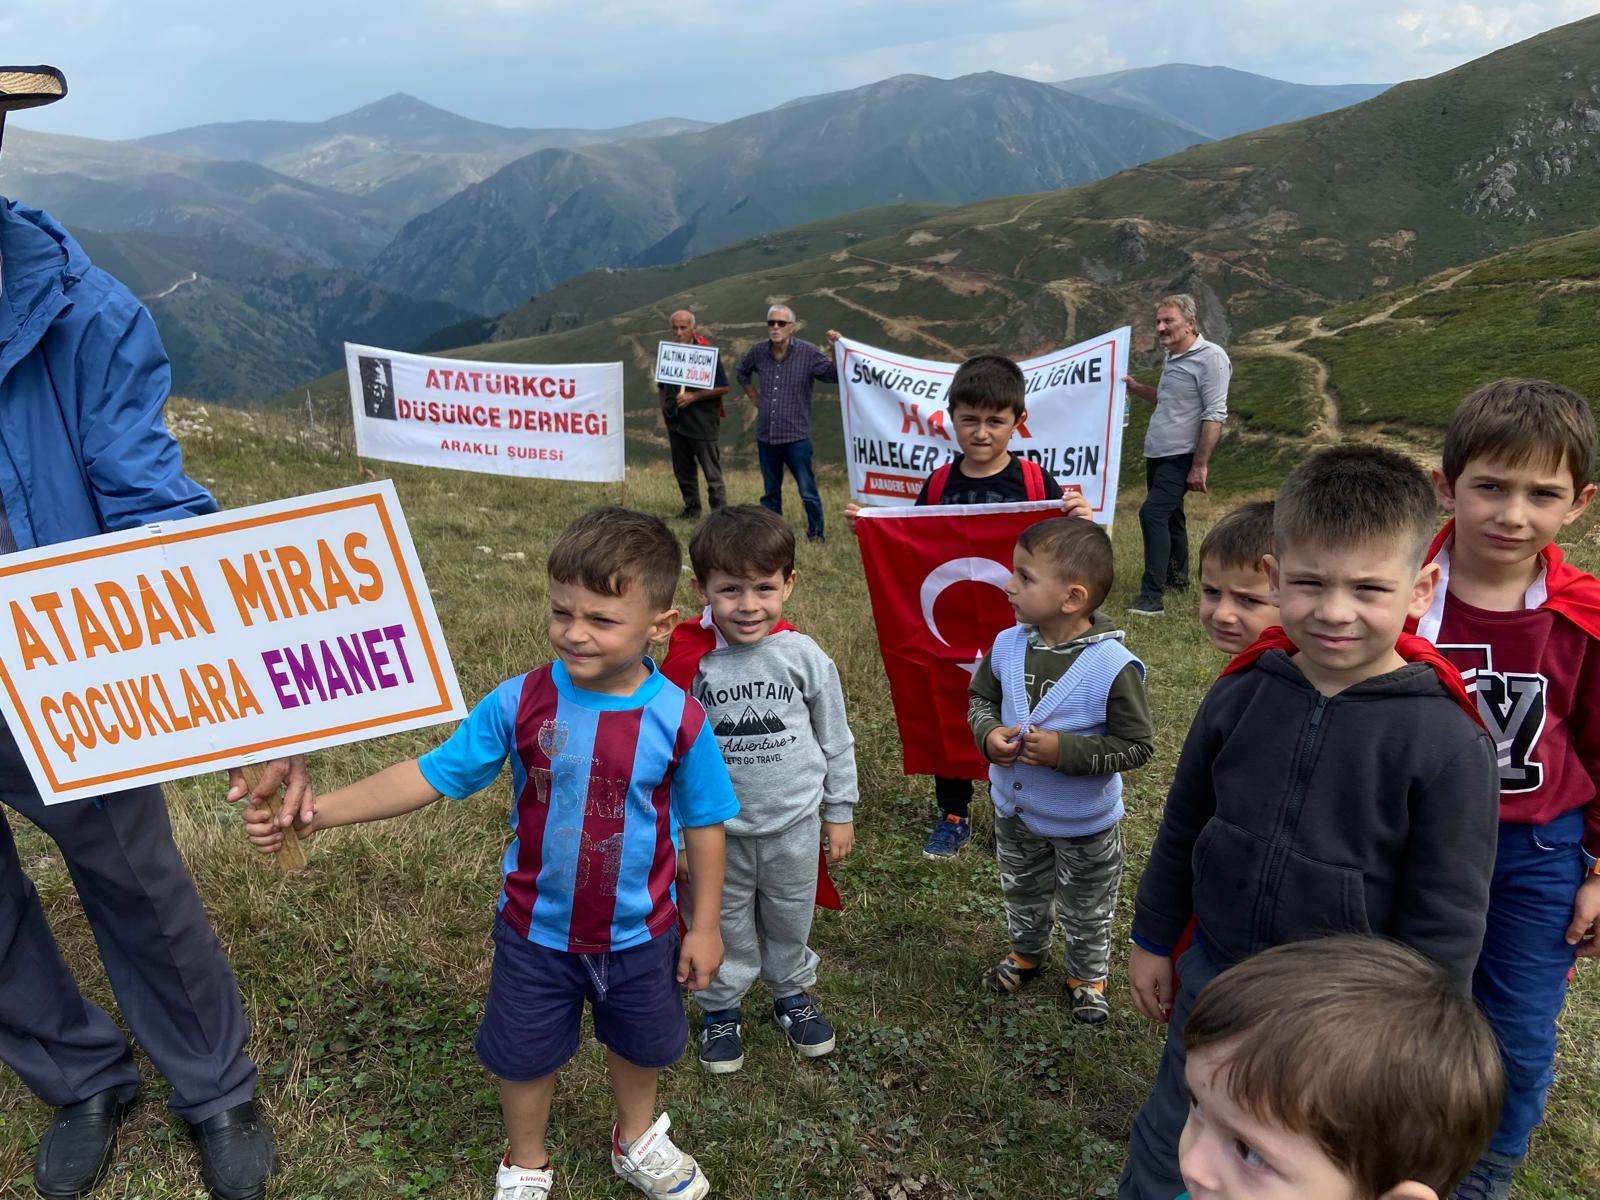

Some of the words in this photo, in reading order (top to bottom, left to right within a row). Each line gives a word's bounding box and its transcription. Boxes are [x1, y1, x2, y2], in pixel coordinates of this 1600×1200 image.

[662, 350, 686, 363] ALTINA
[660, 364, 684, 379] HALKA
[851, 358, 942, 400] SÖMÜRGE
[440, 439, 498, 456] ARAKLI
[9, 565, 215, 671] ATADAN
[40, 658, 264, 762] ÇOCUKLARA
[261, 623, 415, 709] EMANET
[702, 681, 794, 708] MOUNTAIN
[723, 738, 787, 752] Adventure
[744, 756, 754, 765] GO
[757, 753, 782, 764] TRAVEL
